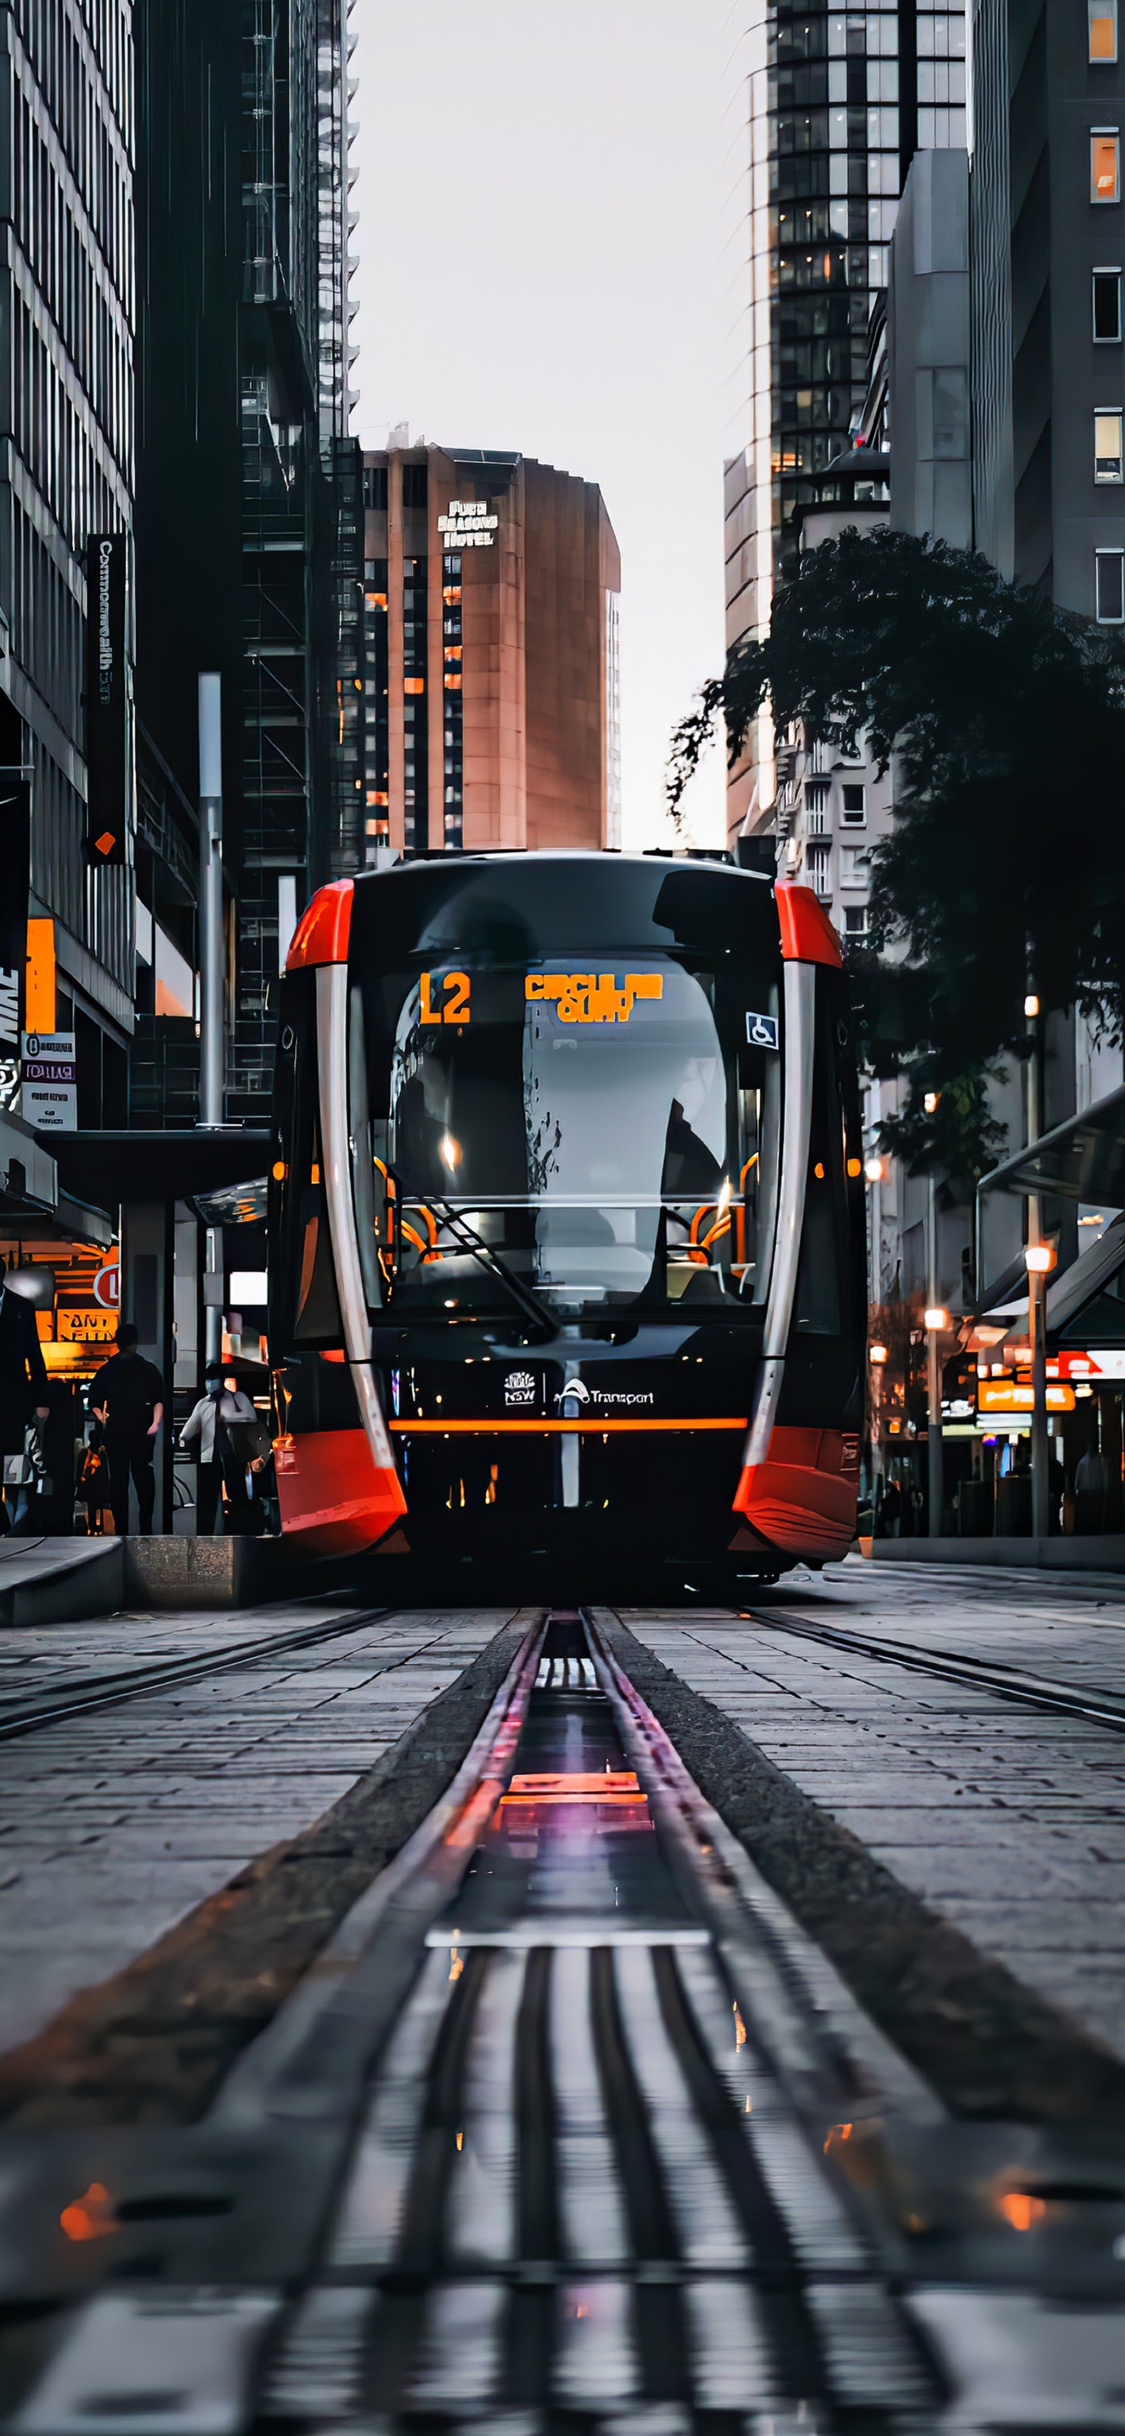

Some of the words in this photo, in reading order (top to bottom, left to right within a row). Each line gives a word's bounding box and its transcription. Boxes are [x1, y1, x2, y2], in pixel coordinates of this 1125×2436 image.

[420, 971, 470, 1024] L2
[505, 1390, 535, 1402] NSW
[590, 1390, 654, 1405] Transport
